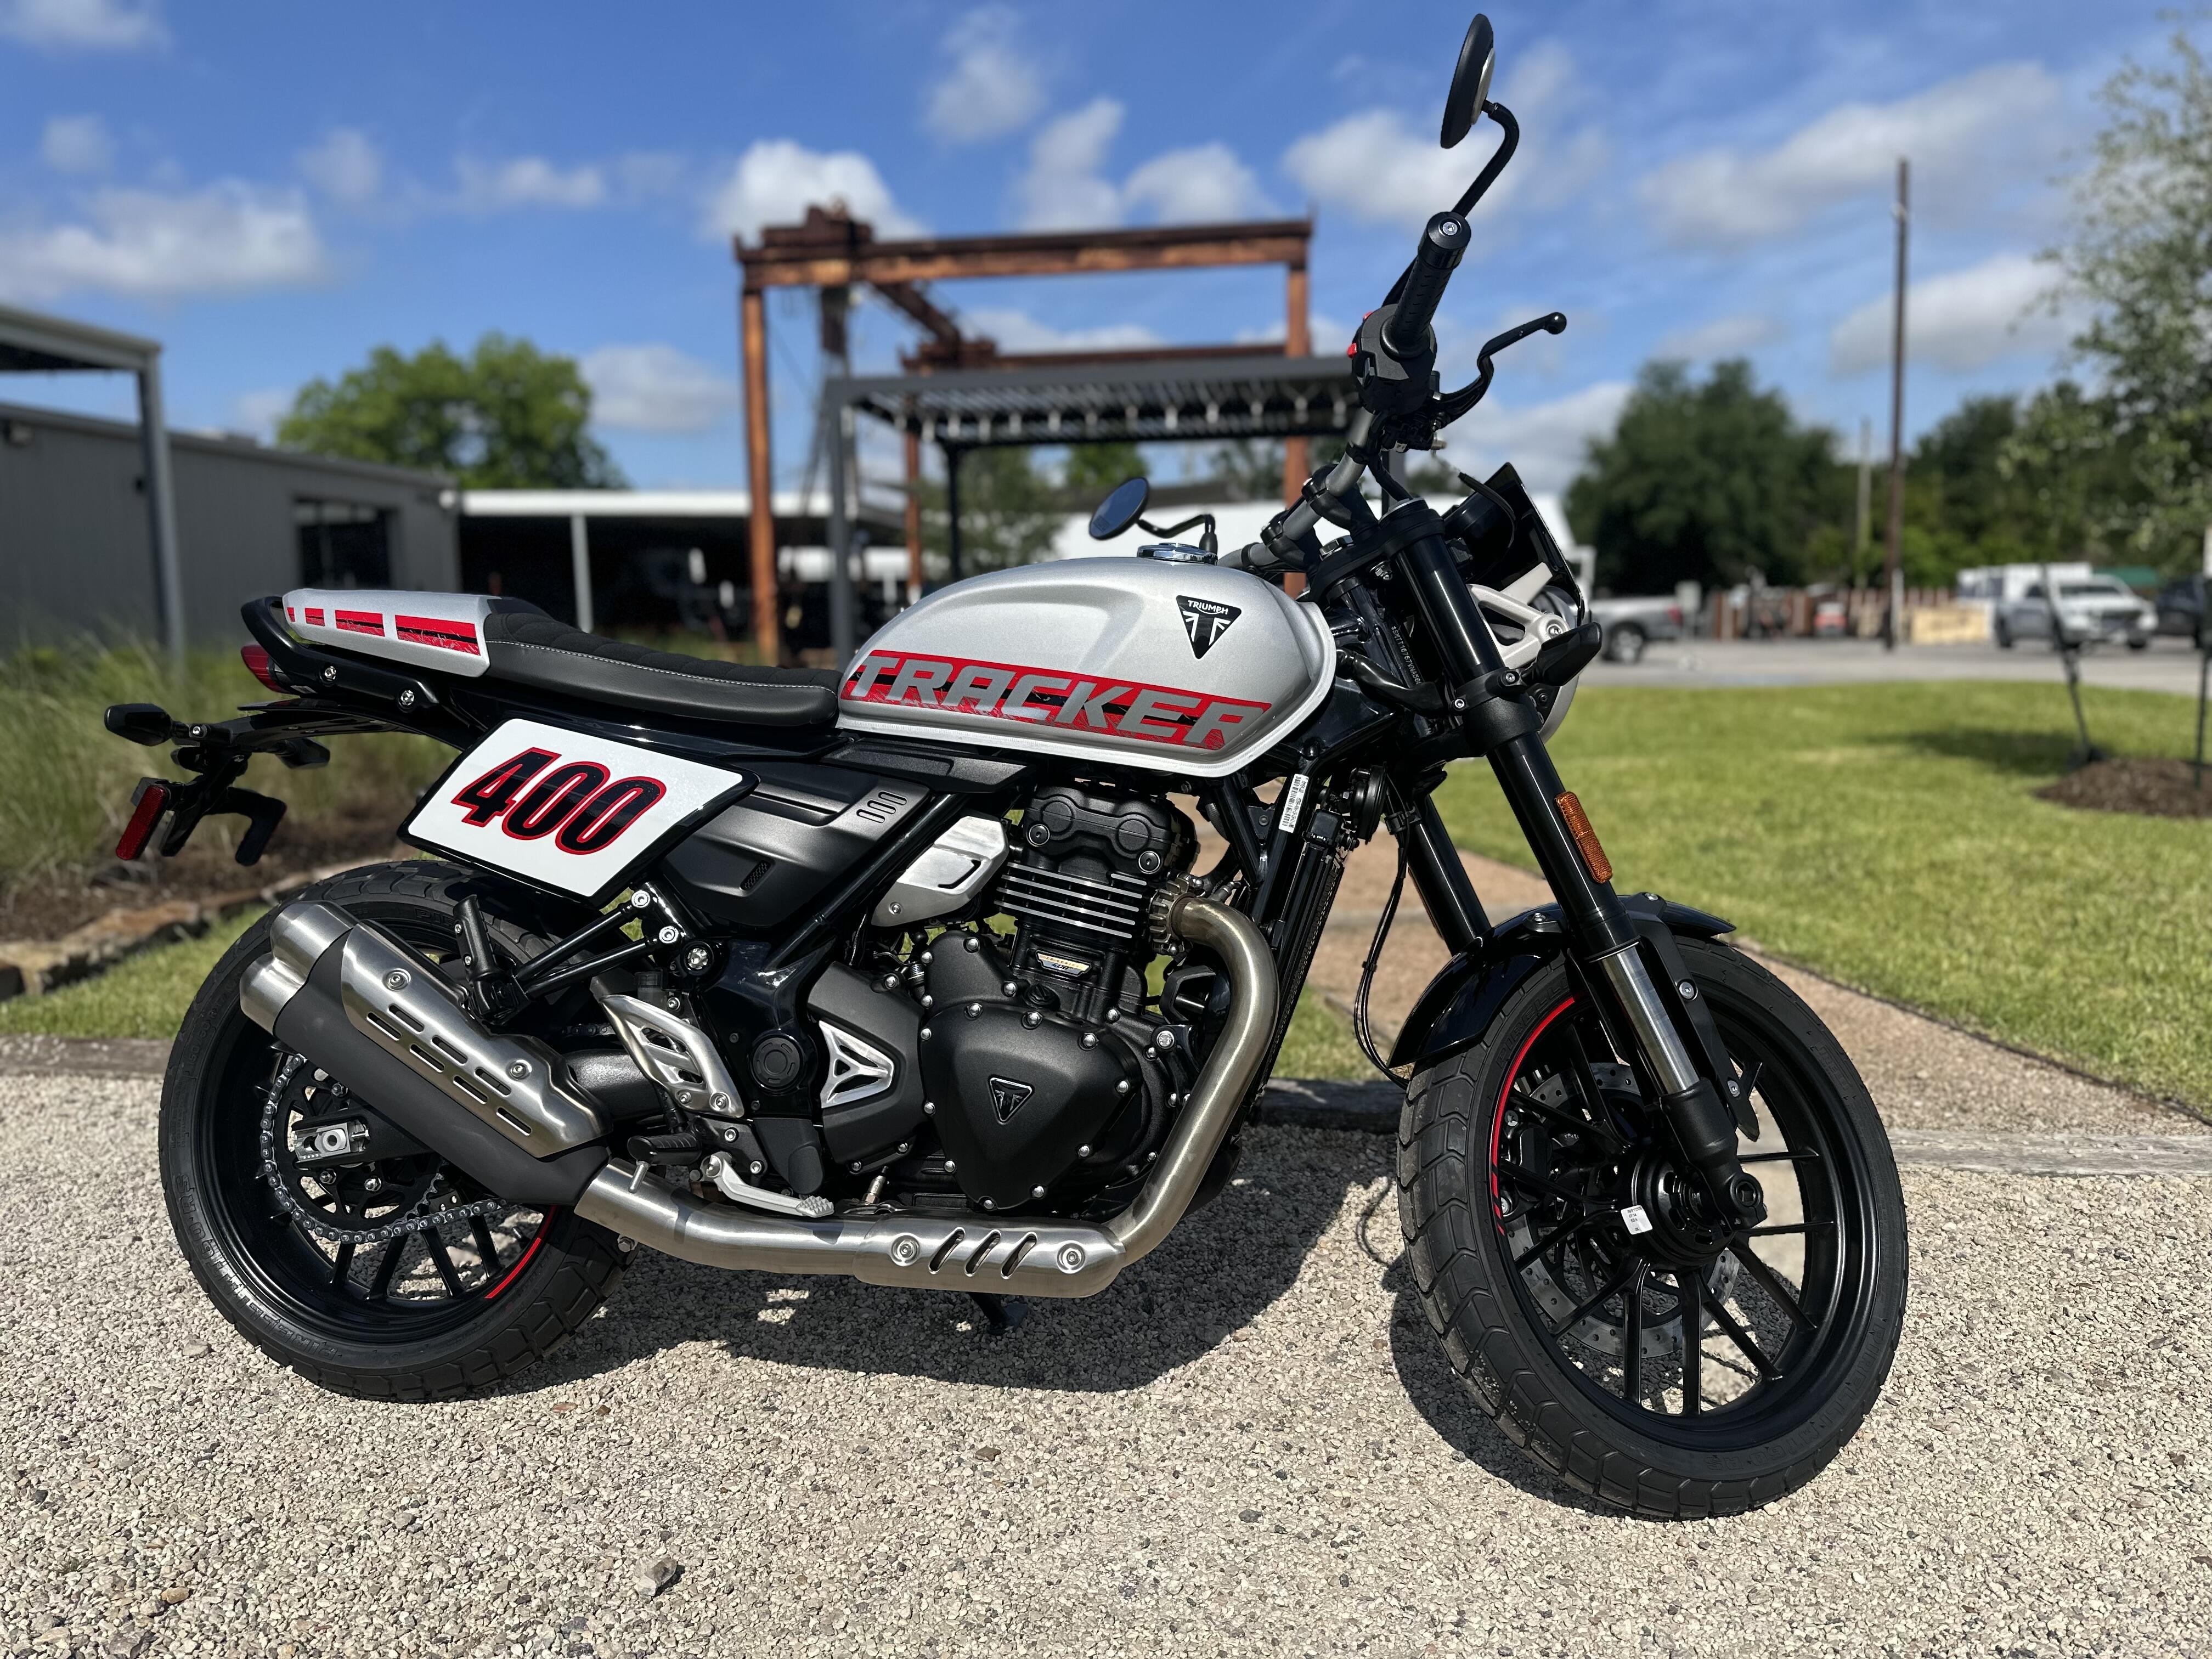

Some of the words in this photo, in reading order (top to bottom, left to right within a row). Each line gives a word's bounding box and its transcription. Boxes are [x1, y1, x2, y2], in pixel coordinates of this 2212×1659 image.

[1188, 600, 1228, 614] TRIUMPH
[849, 656, 1265, 744] TRACKER
[450, 747, 667, 855] 400
[237, 1295, 338, 1362] PIRELLI
